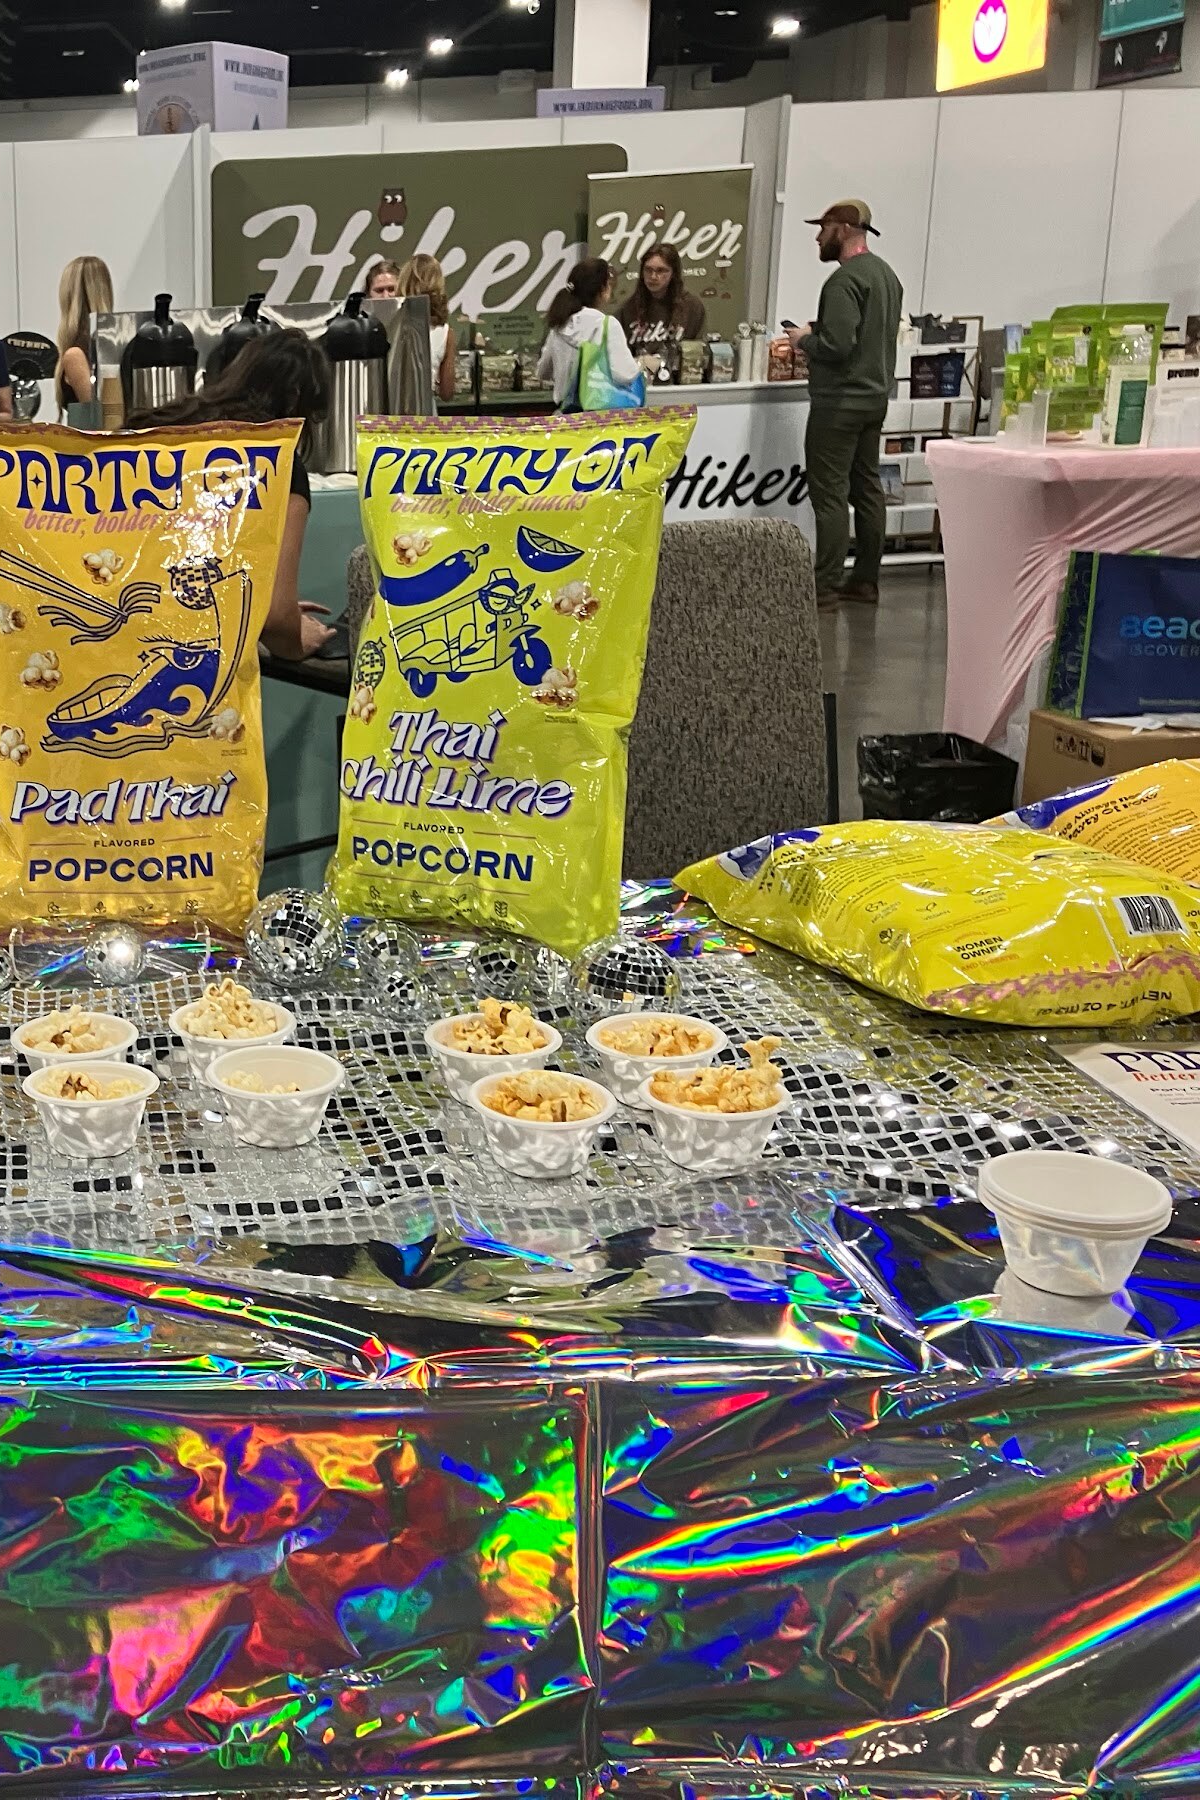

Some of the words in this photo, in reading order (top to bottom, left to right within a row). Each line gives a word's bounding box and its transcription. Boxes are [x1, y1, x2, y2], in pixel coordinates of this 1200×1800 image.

[596, 210, 743, 264] Hiker
[204, 446, 282, 510] OF
[364, 446, 572, 499] PARTY
[572, 433, 662, 492] OF
[664, 455, 809, 511] Hiker
[390, 492, 453, 517] better,
[518, 489, 593, 513] snacks
[24, 509, 86, 538] better,
[93, 510, 158, 534] bolder
[389, 708, 508, 762] Thai
[10, 779, 124, 825] Pad
[126, 770, 239, 825] Thai
[340, 755, 434, 805] Chili
[426, 761, 576, 819] Lime
[94, 838, 155, 848] FLAVORED
[403, 821, 465, 835] FLAVORED
[28, 852, 215, 883] POPCORN
[352, 836, 534, 882] POPCORN
[953, 936, 1004, 953] WOMEN
[1082, 1002, 1102, 1011] OZ
[1142, 990, 1172, 1001] NET
